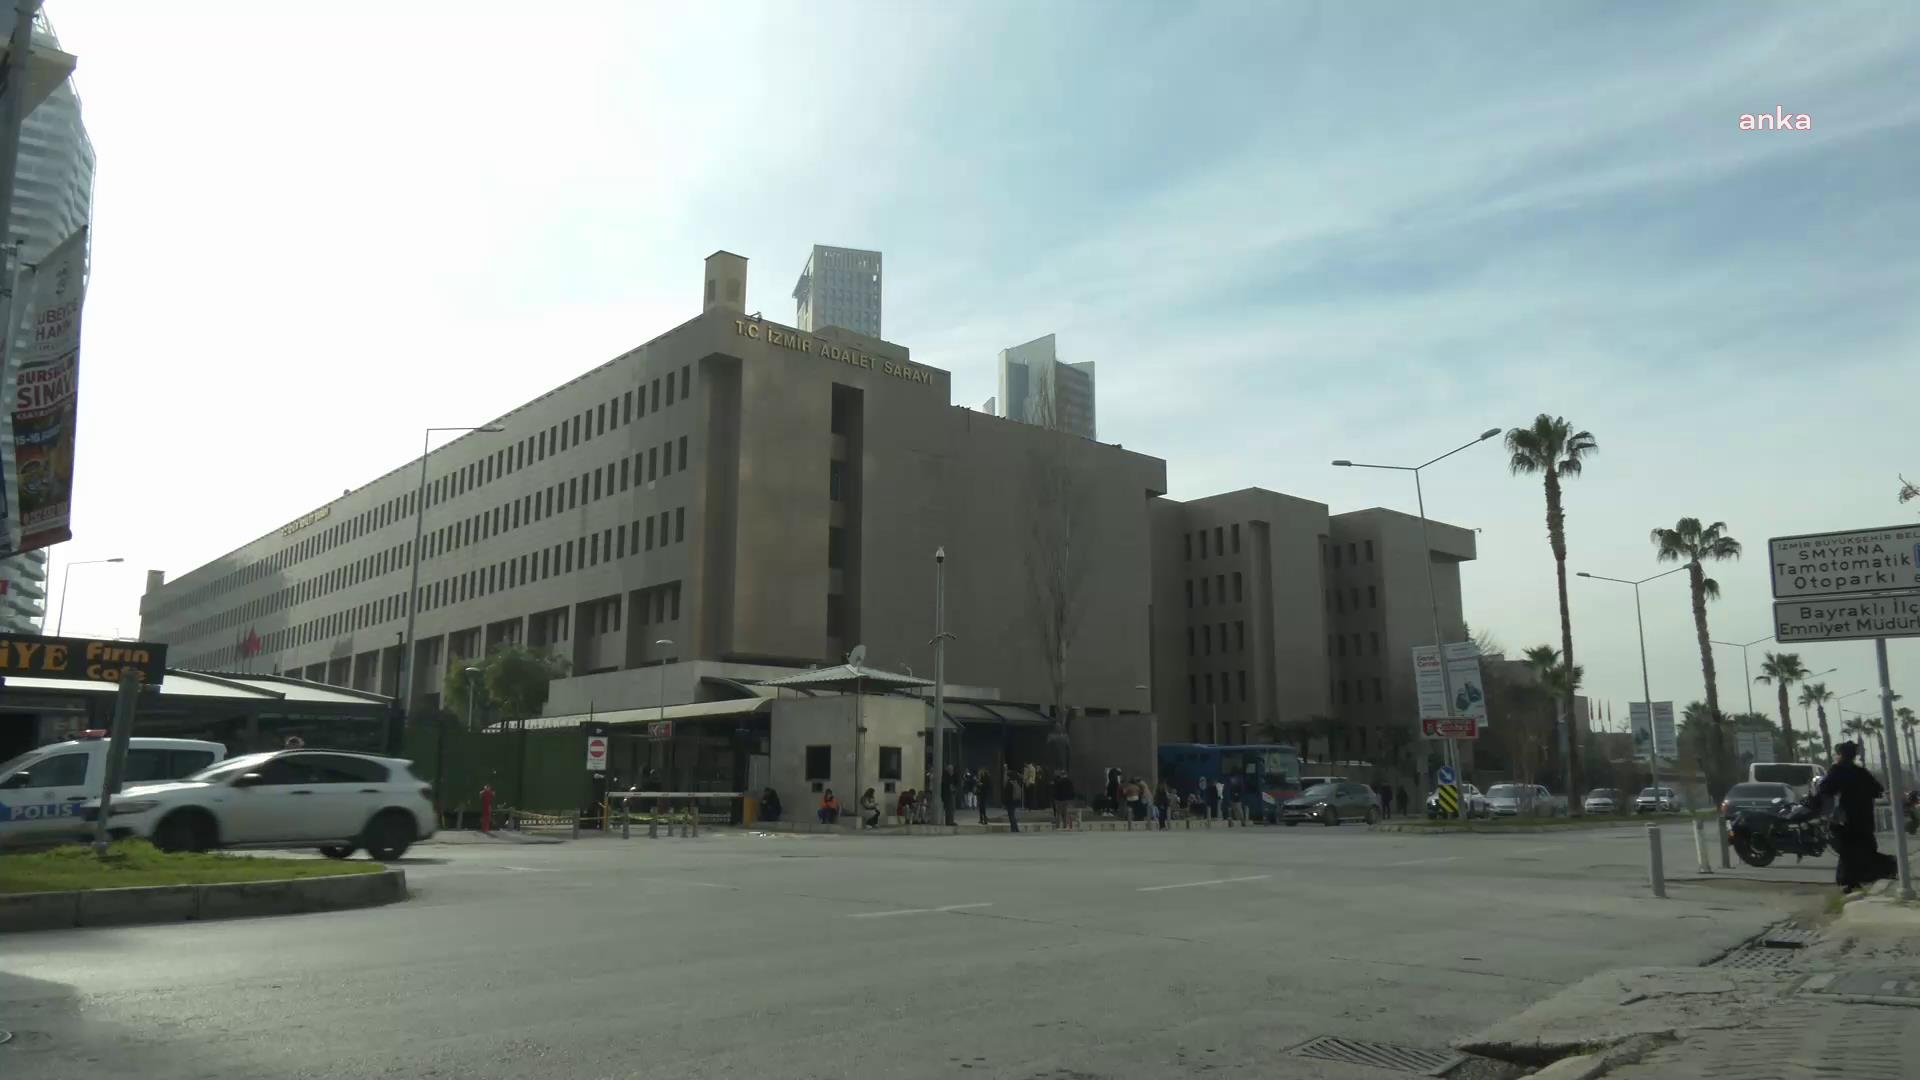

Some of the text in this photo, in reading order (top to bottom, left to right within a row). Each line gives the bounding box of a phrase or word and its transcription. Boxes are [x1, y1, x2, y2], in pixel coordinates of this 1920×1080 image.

[767, 325, 812, 353] İZMİR
[820, 344, 876, 370] ADALET
[884, 360, 933, 385] SARAYI
[1799, 544, 1884, 560] SMYRNA
[1776, 552, 1911, 576] Tamotomatik
[1794, 570, 1896, 590] Otoparkı
[1800, 602, 1885, 621] Bayraklı
[1780, 619, 1851, 637] Emniyet
[10, 803, 73, 820] POLİS
